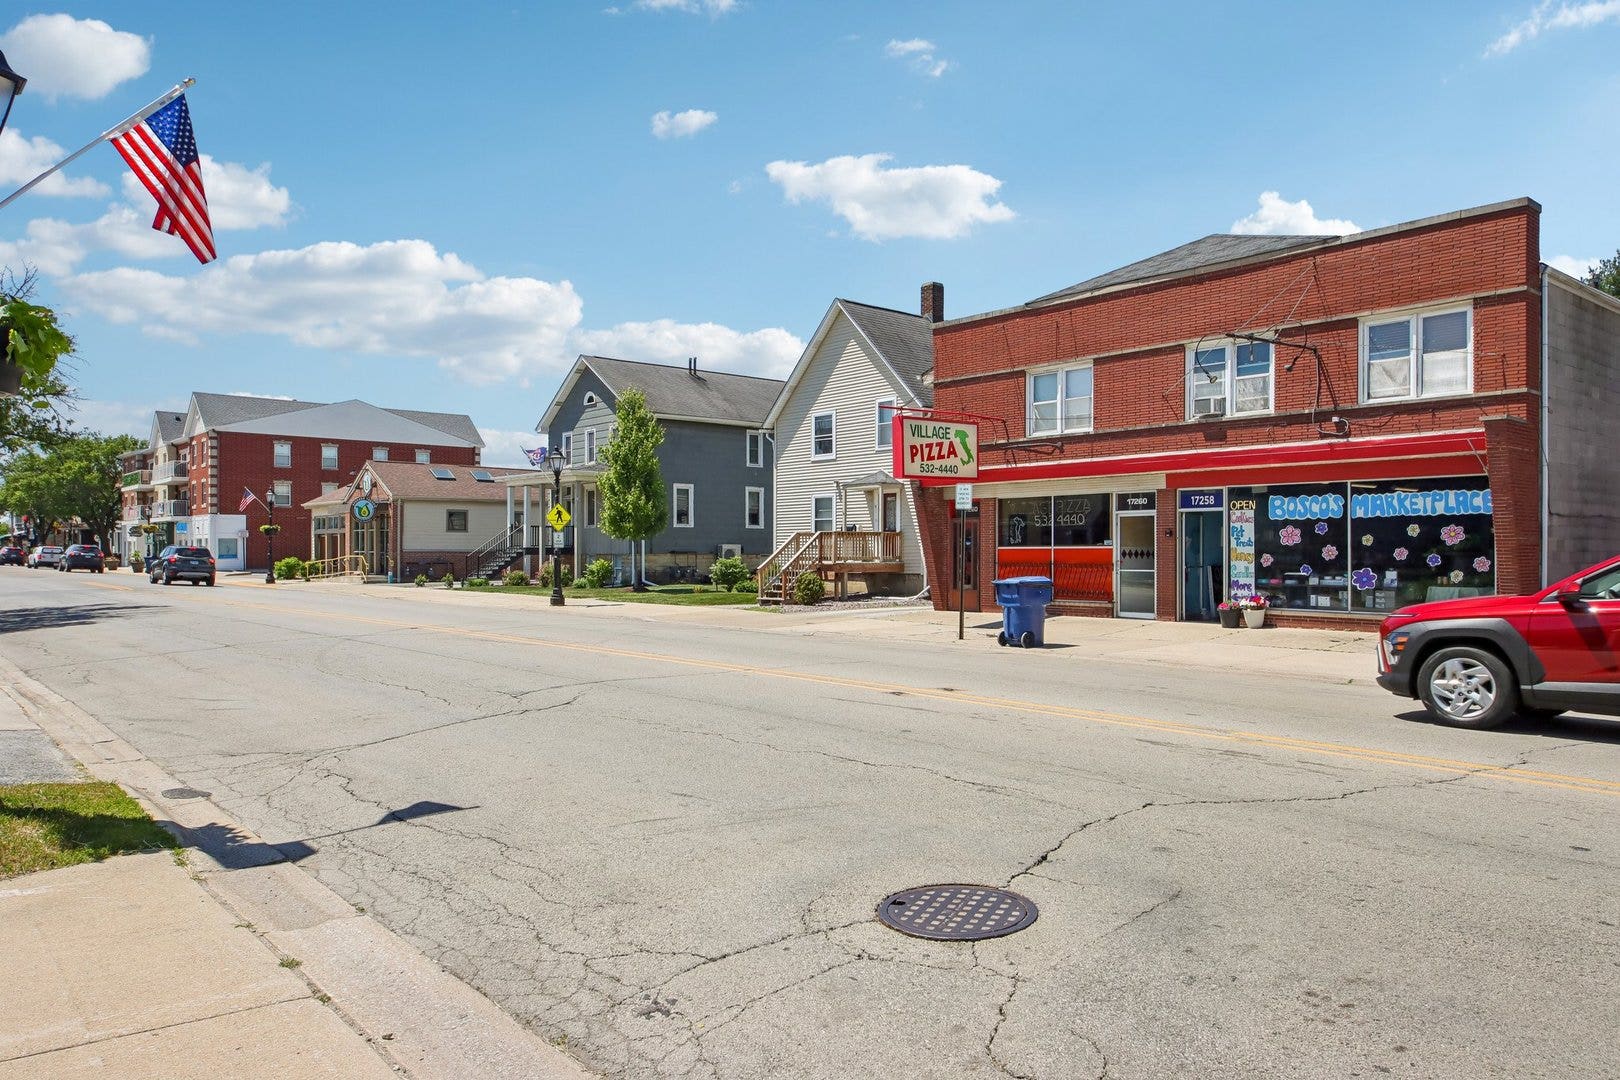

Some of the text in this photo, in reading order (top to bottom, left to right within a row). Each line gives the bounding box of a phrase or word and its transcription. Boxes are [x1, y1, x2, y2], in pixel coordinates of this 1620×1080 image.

[909, 423, 951, 440] VILLAGE
[909, 440, 958, 464] PIZZA
[919, 463, 959, 475] 532-4440
[1056, 498, 1091, 514] PZZA
[1126, 497, 1148, 505] 17260
[1190, 495, 1215, 505] 17258
[1230, 500, 1256, 510] OPEN
[1268, 489, 1493, 520] BOSCO'S MARKETPLACE
[1231, 525, 1245, 538] Pet
[1231, 579, 1253, 592] More
